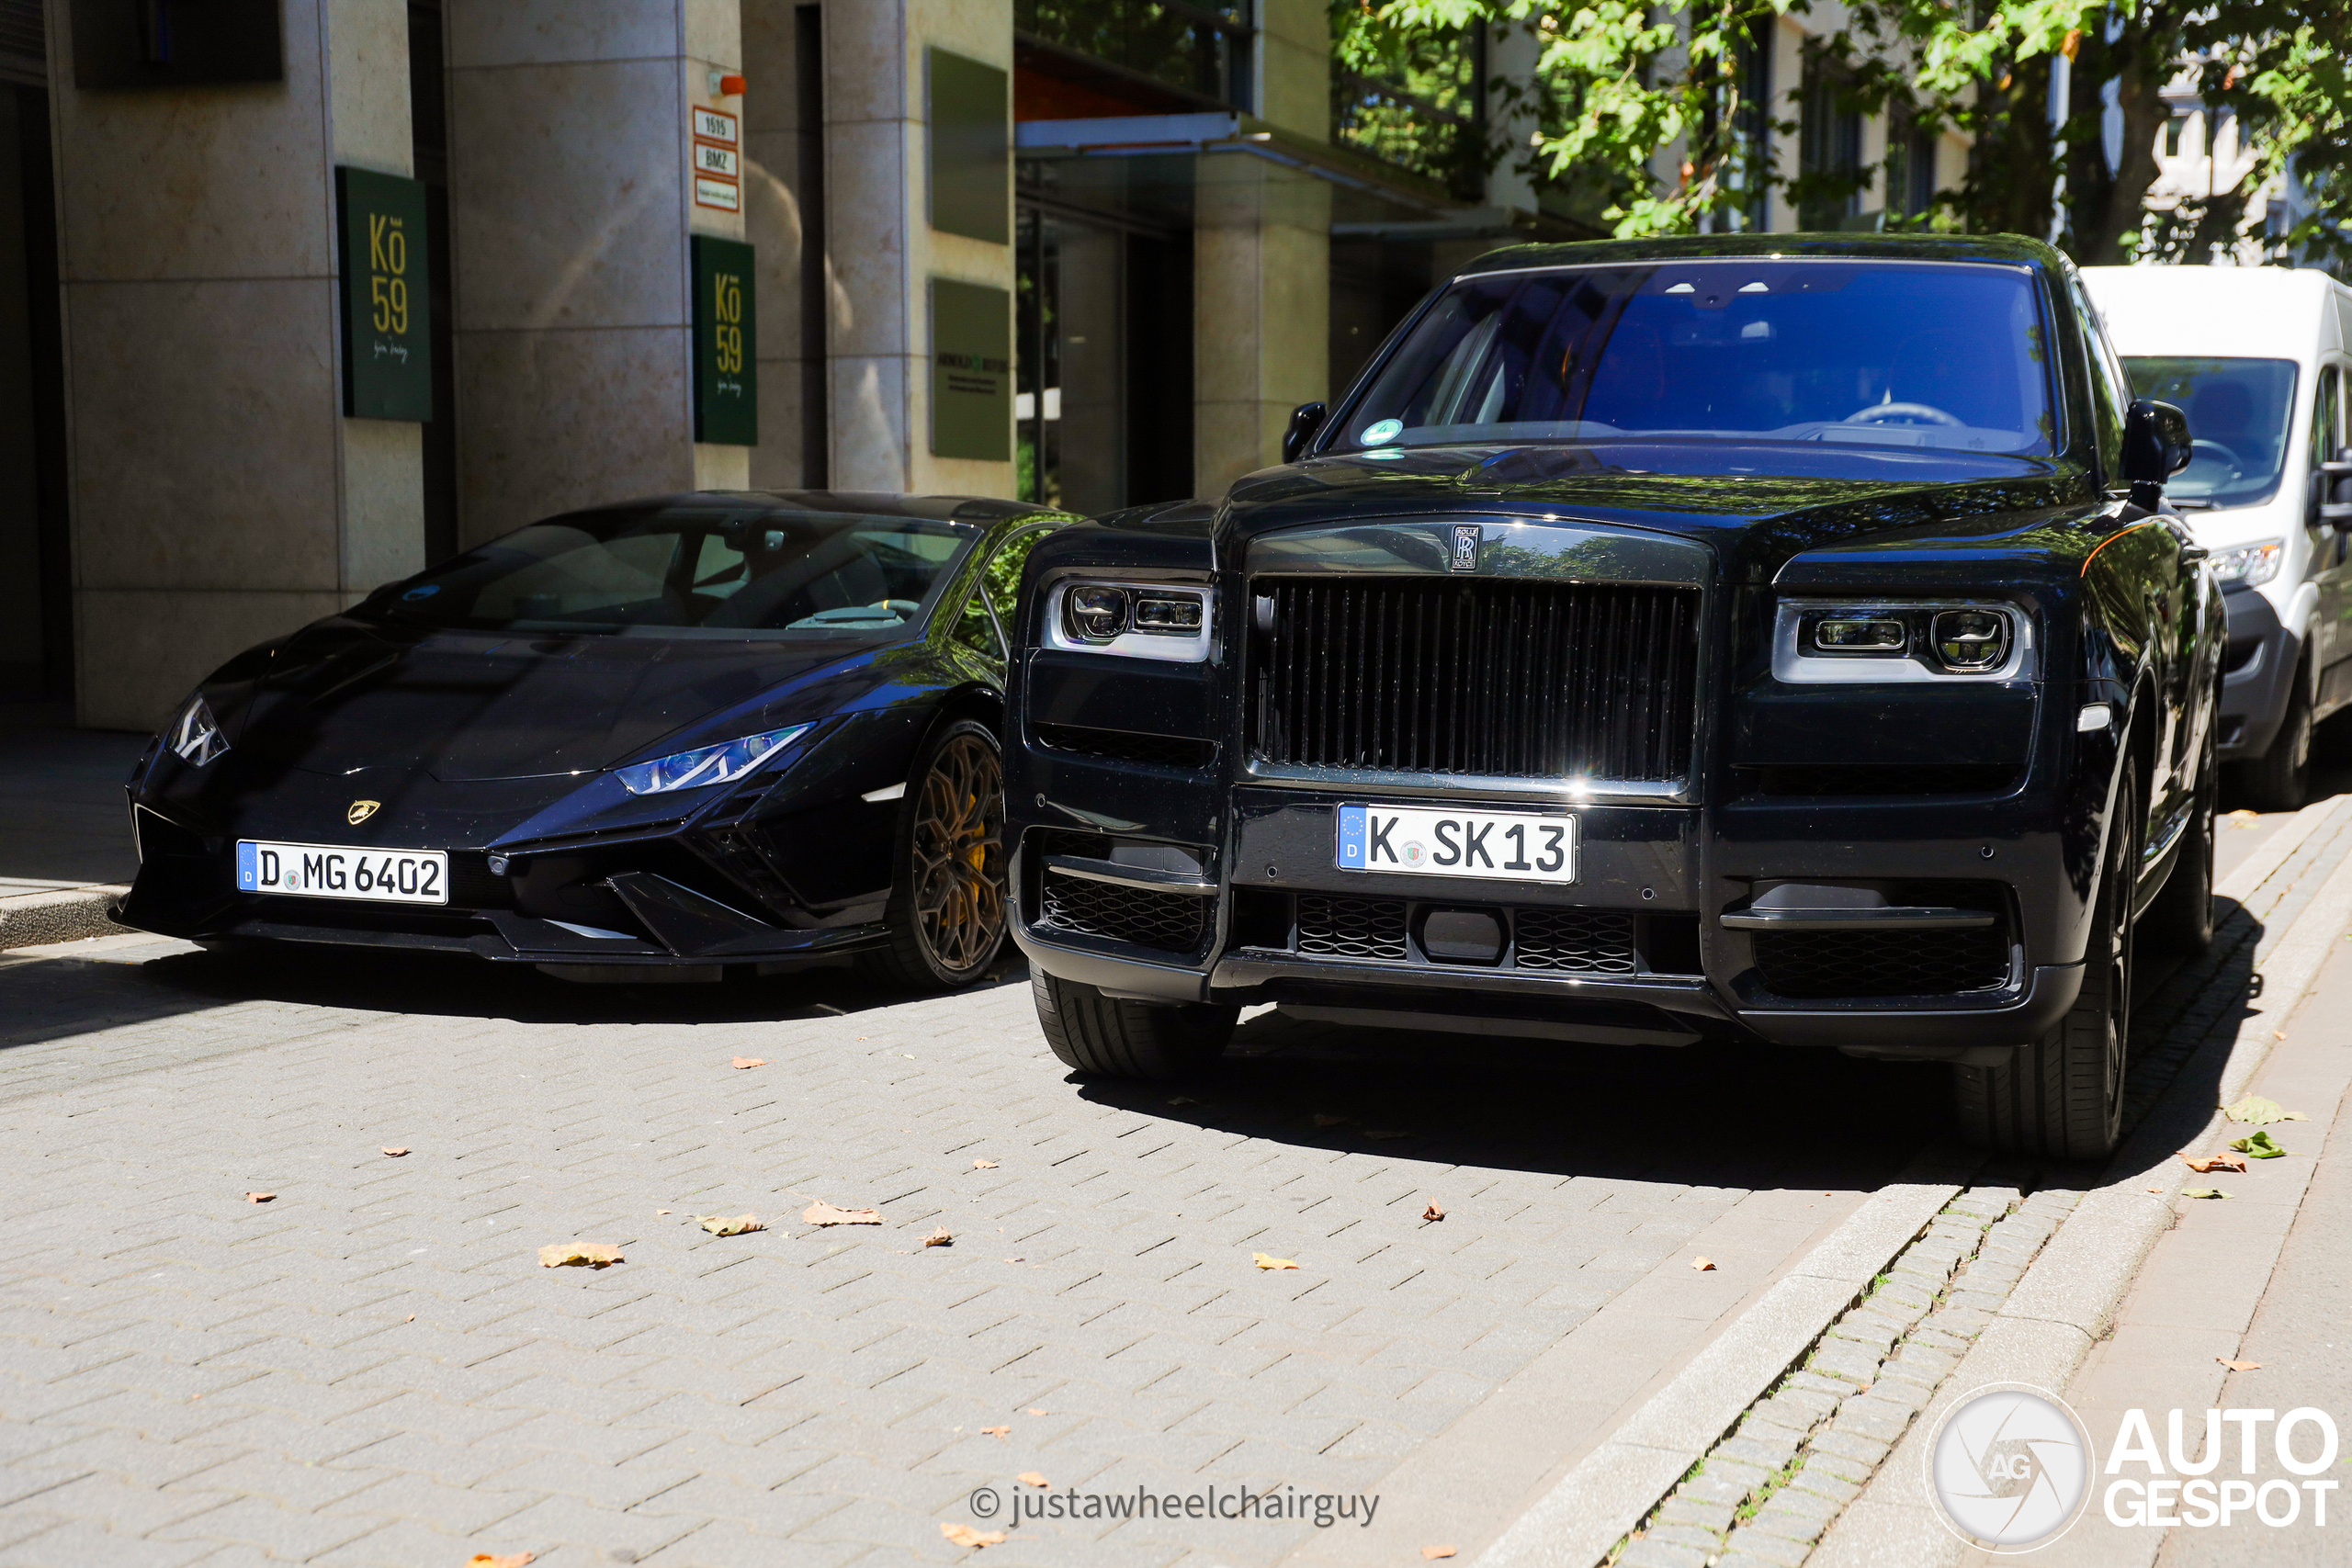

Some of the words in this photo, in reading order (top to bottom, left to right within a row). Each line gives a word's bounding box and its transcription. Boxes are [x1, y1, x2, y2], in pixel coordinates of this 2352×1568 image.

[706, 116, 726, 136] 1515
[706, 149, 727, 171] BMZ
[372, 276, 408, 335] 59
[717, 324, 741, 373] 59
[1347, 844, 1358, 857] D
[1371, 816, 1399, 863] K
[244, 871, 253, 882] D
[261, 850, 279, 886] D
